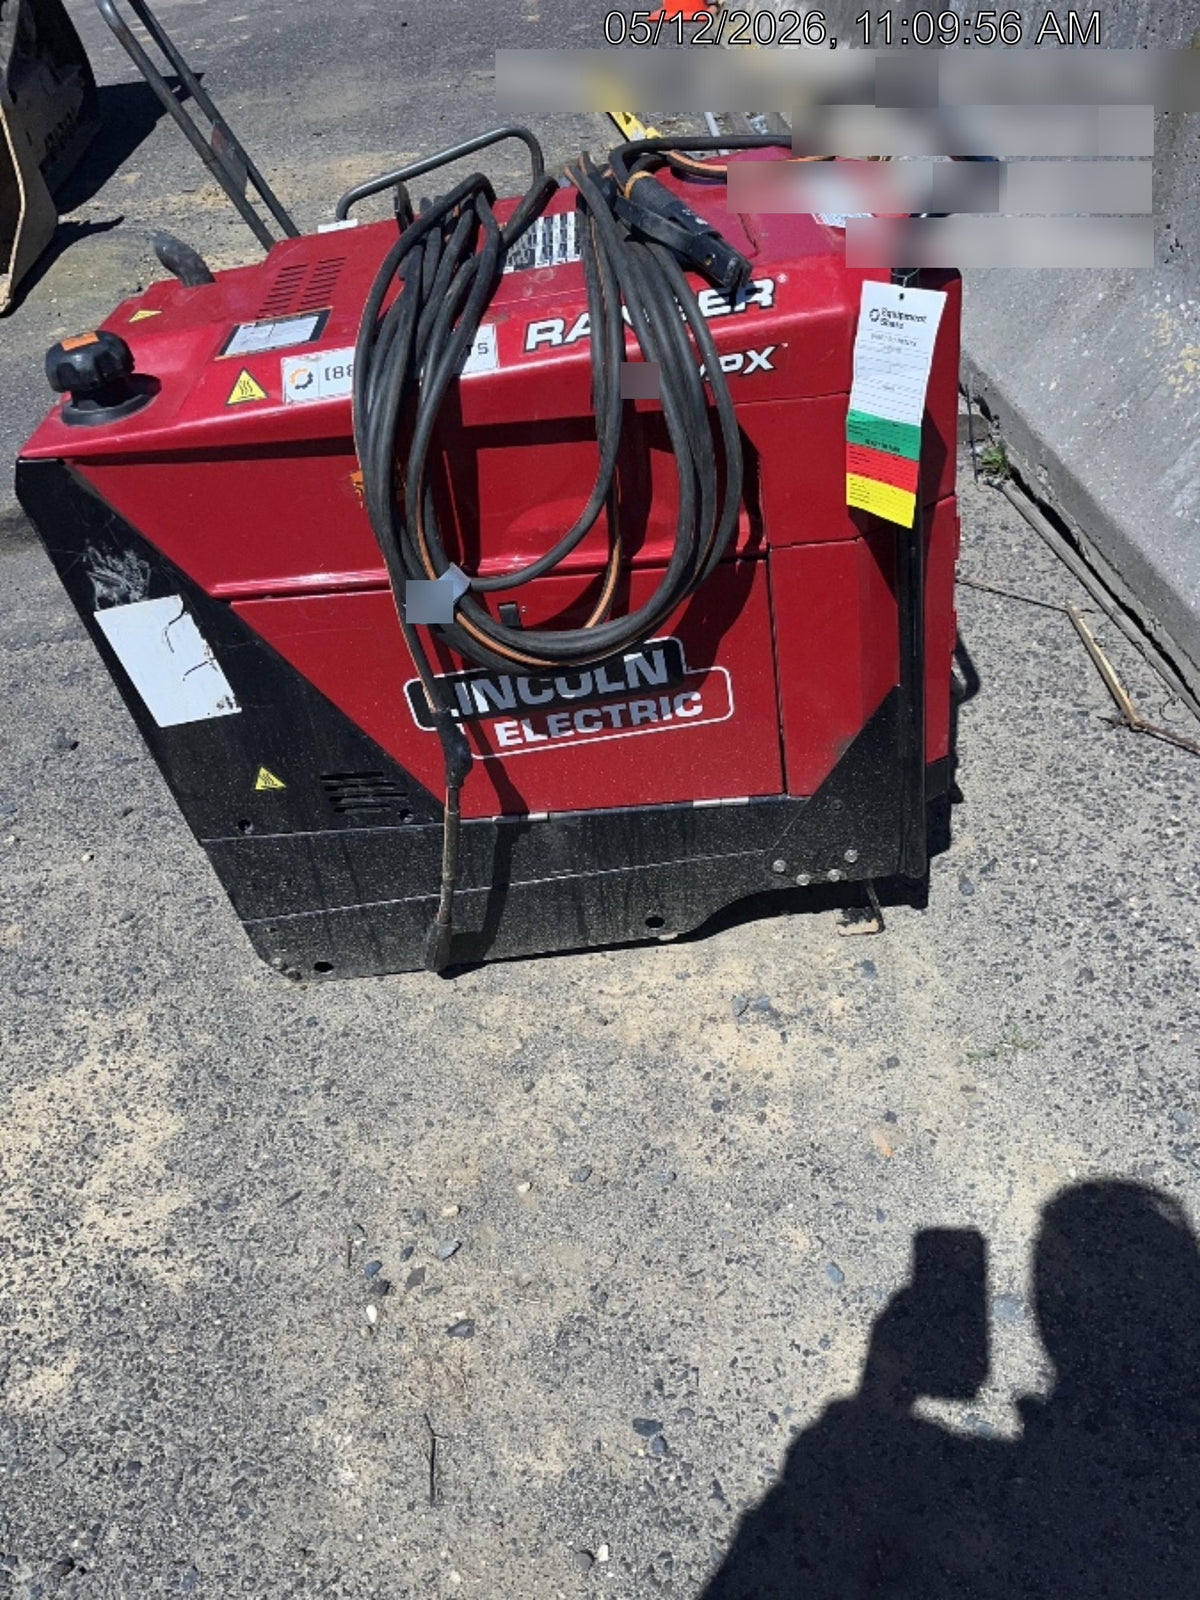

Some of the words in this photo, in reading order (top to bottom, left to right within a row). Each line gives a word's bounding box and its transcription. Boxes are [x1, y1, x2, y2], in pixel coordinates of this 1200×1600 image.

[525, 278, 775, 351] RAER
[450, 649, 670, 718] INCOLN
[493, 691, 704, 748] ELECTRIC
